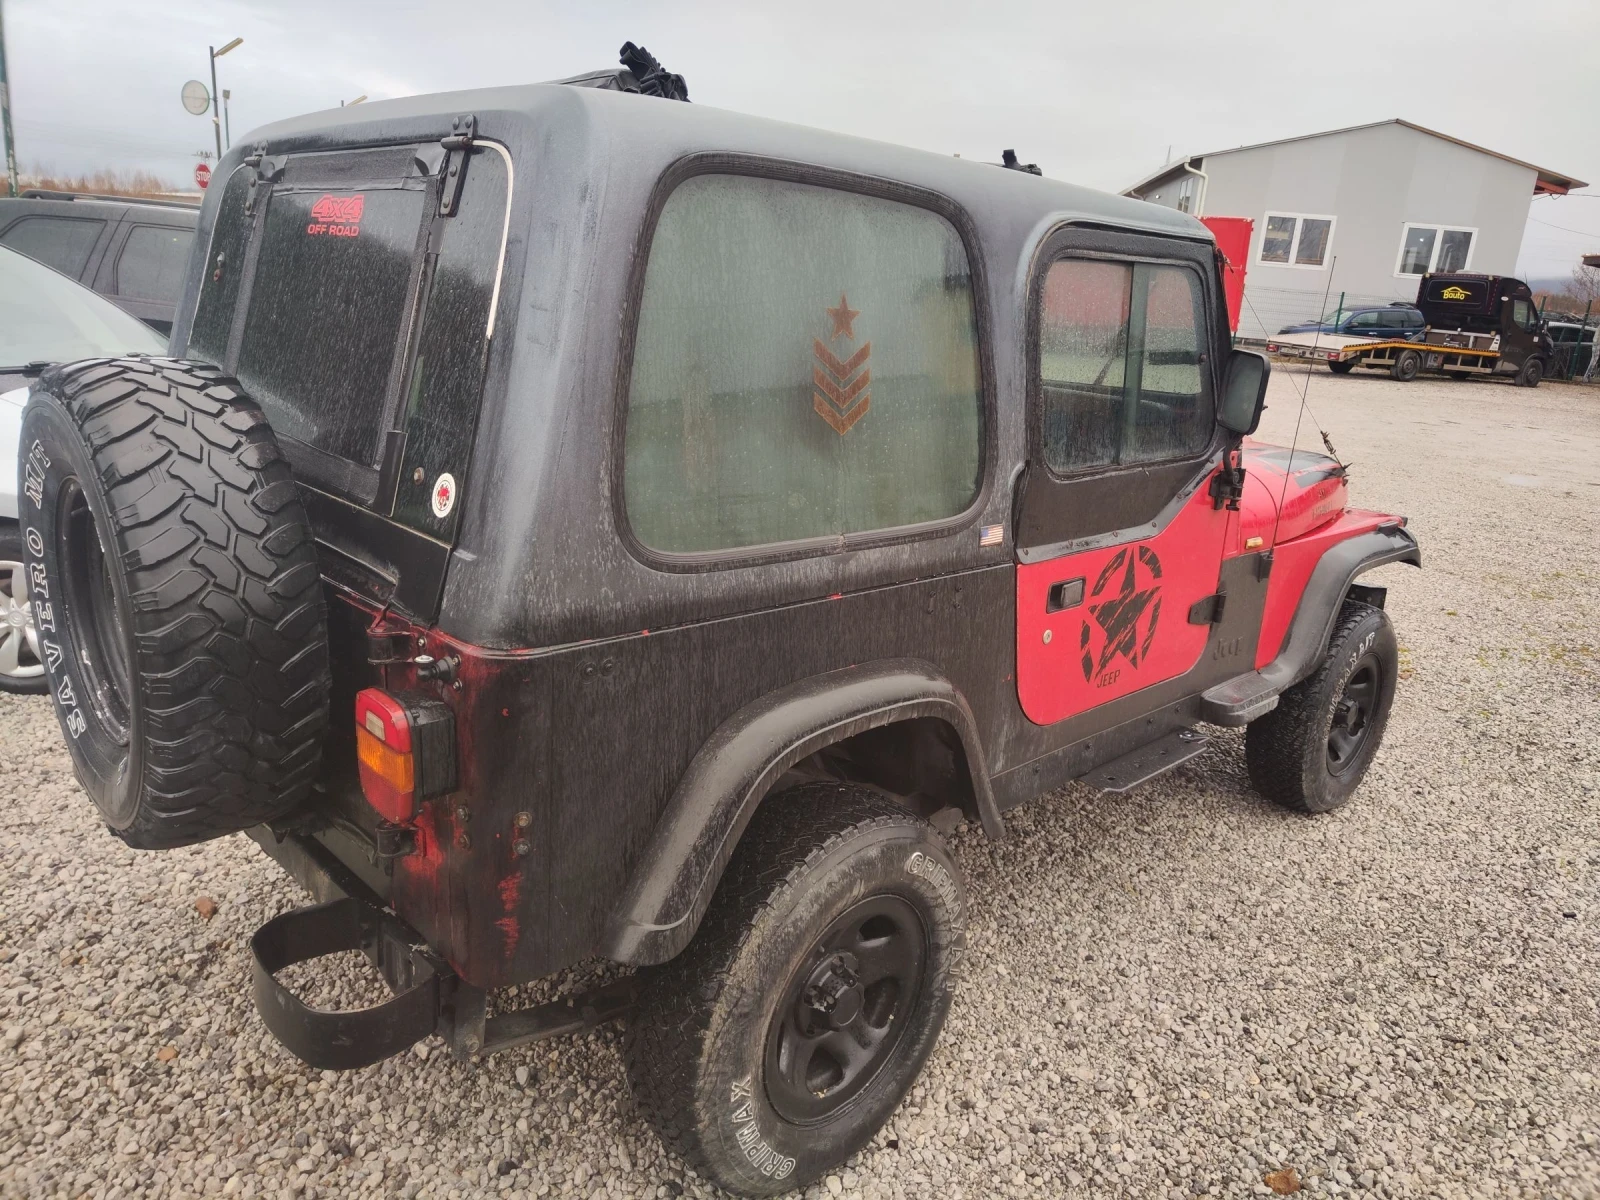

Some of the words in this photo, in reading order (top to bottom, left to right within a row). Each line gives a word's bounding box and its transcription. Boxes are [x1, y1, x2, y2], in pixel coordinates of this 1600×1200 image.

[196, 171, 211, 181] STOP
[307, 224, 327, 235] OFF
[329, 225, 359, 237] ROAD
[24, 440, 51, 508] M/T
[26, 526, 86, 739] SAVERO
[1096, 669, 1121, 688] JEEP
[908, 852, 964, 941] GRIPMAX
[731, 1076, 796, 1179] GRIPMAX
